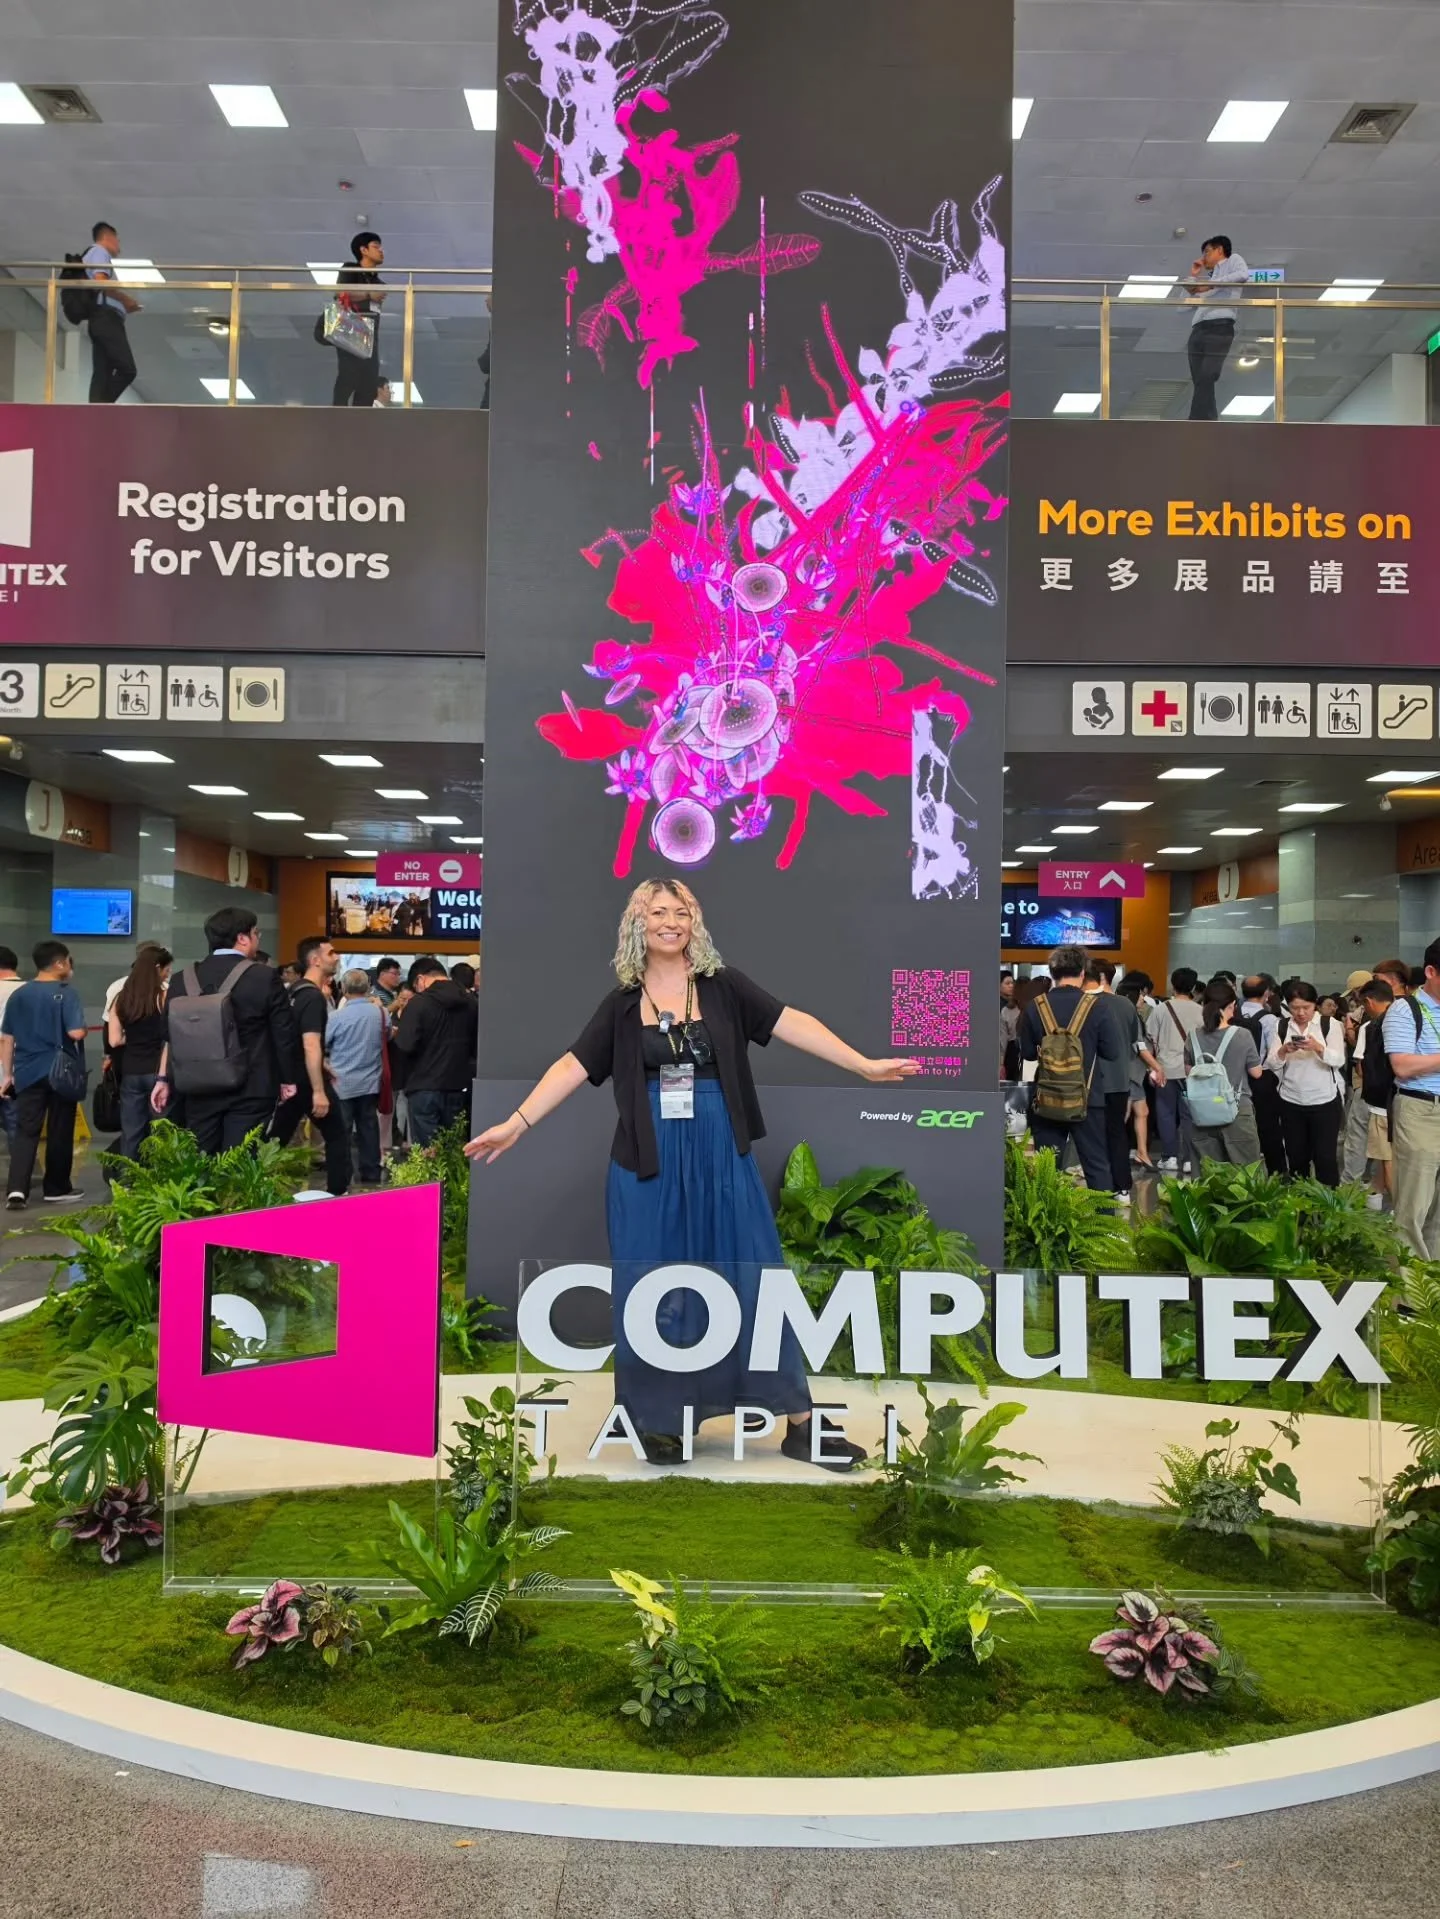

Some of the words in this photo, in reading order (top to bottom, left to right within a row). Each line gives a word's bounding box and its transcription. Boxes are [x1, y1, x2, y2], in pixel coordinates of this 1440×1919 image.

[118, 482, 406, 532] Registration
[1038, 499, 1153, 537] More
[1167, 501, 1347, 539] Exhibits
[1357, 512, 1412, 540] on
[131, 538, 203, 575] for
[209, 541, 390, 580] Visitors
[0, 563, 68, 586] TEX
[1039, 557, 1411, 594] 更多展品請至
[0, 669, 25, 704] 3
[404, 861, 421, 870] NO
[1412, 842, 1440, 868] Are
[394, 872, 430, 881] ENTER
[1055, 870, 1090, 879] ENTRY
[1063, 881, 1083, 890] 入口
[1018, 899, 1039, 915] to
[932, 1067, 942, 1076] to
[945, 1067, 961, 1078] try!
[860, 1111, 900, 1121] Powered
[901, 1112, 913, 1122] by
[916, 1109, 984, 1129] acer
[517, 1263, 1391, 1384] COMPUTEX
[515, 1402, 898, 1465] TAIPEI
